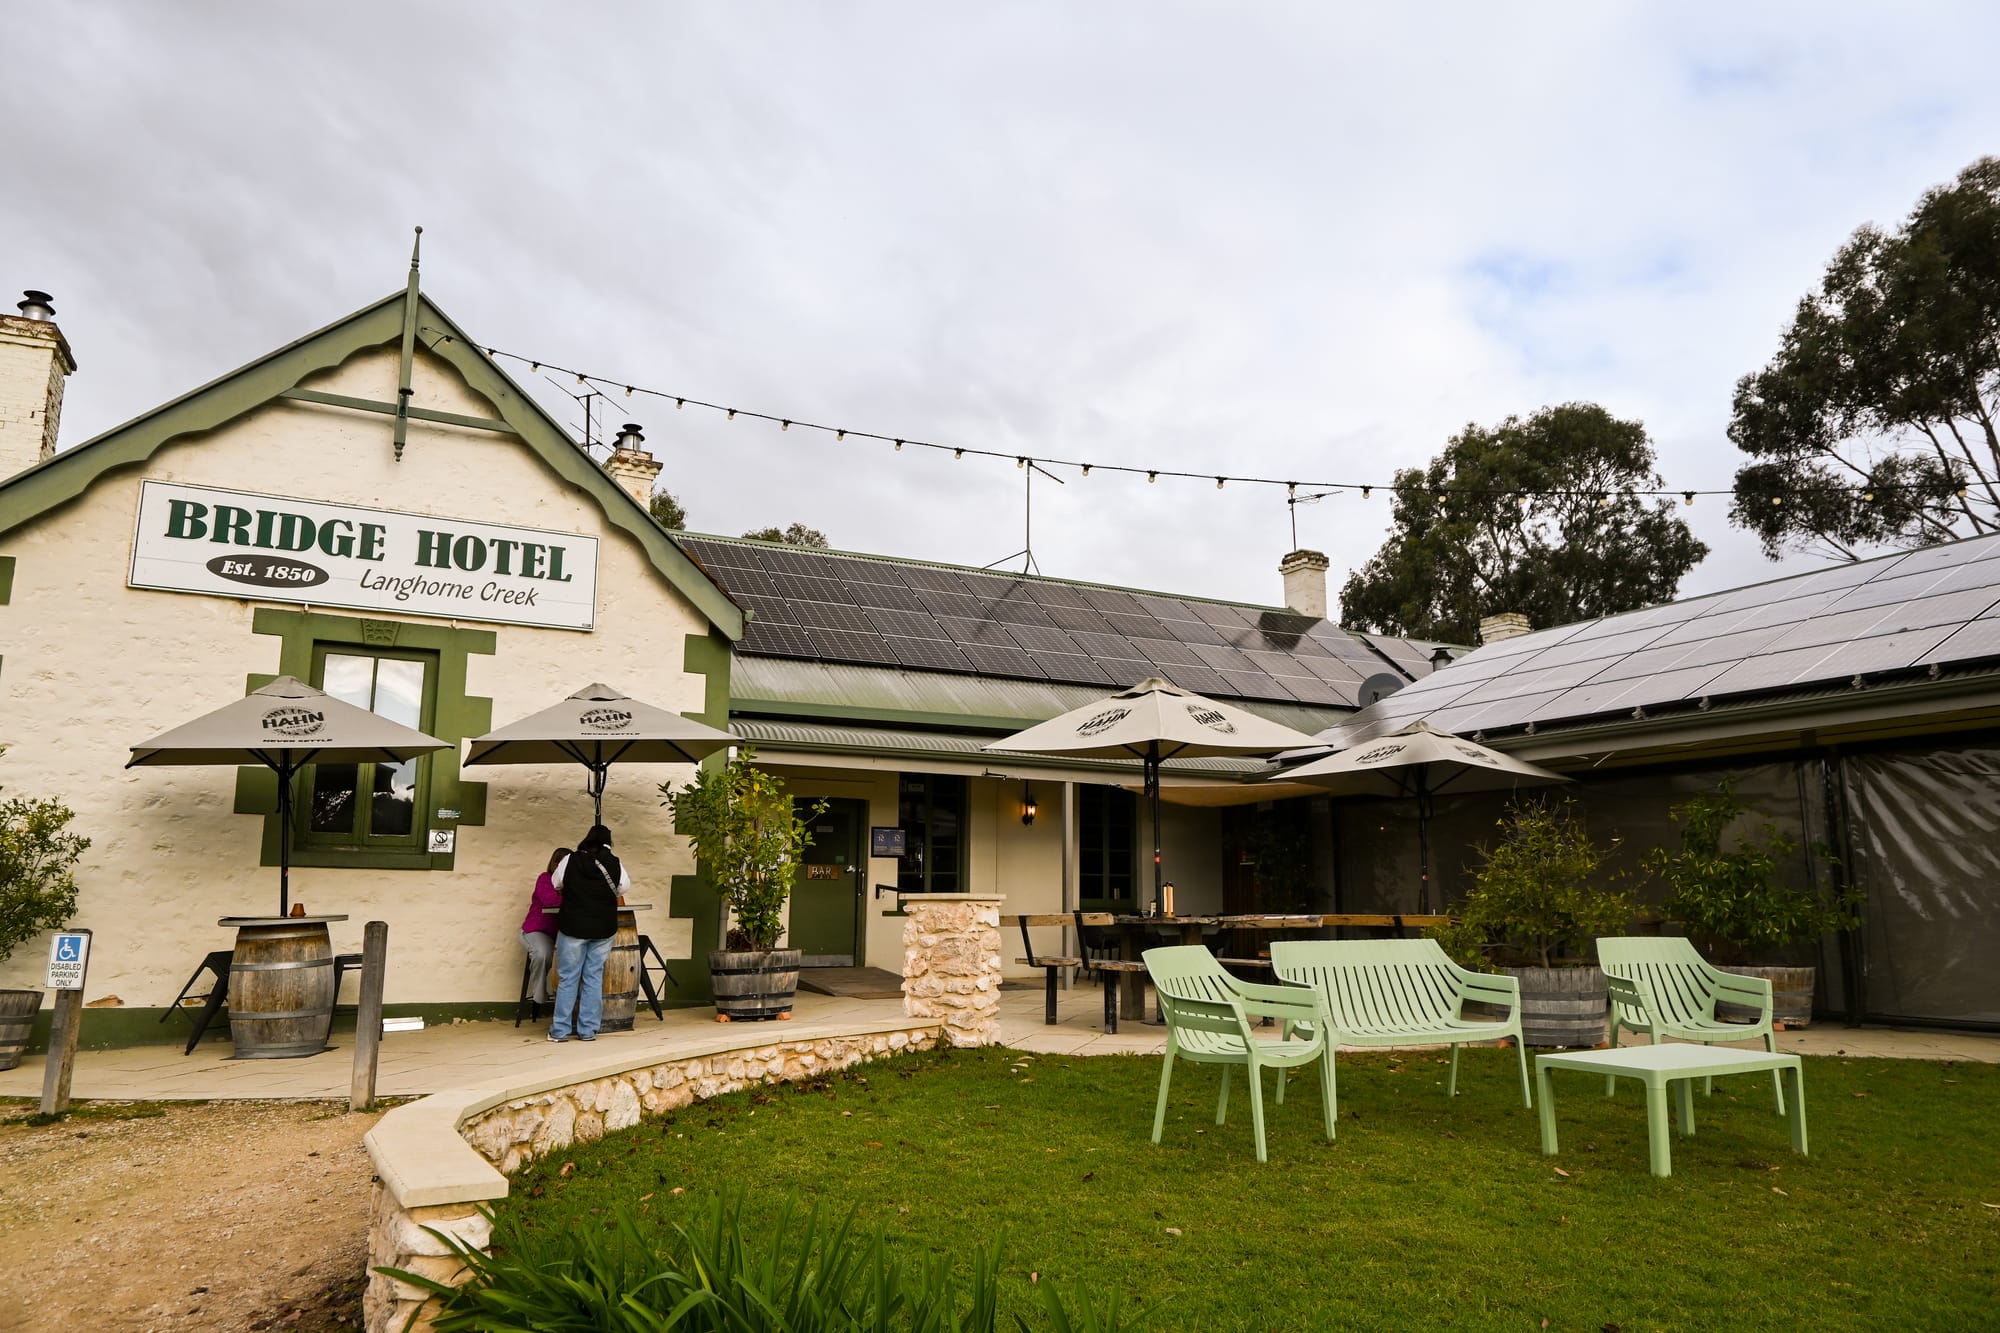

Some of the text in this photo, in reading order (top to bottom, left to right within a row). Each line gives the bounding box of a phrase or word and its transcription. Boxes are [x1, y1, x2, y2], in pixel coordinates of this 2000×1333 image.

[164, 498, 573, 583] BRIDGE HOTEL
[221, 559, 316, 583] Est. 1850
[360, 568, 539, 607] Langhorne Creek
[262, 711, 325, 729] HAHN
[580, 711, 632, 724] HAHN
[1076, 708, 1133, 732] HAHN
[1191, 710, 1226, 725] HAHN
[811, 865, 832, 875] BAR
[50, 962, 82, 971] DISABLED
